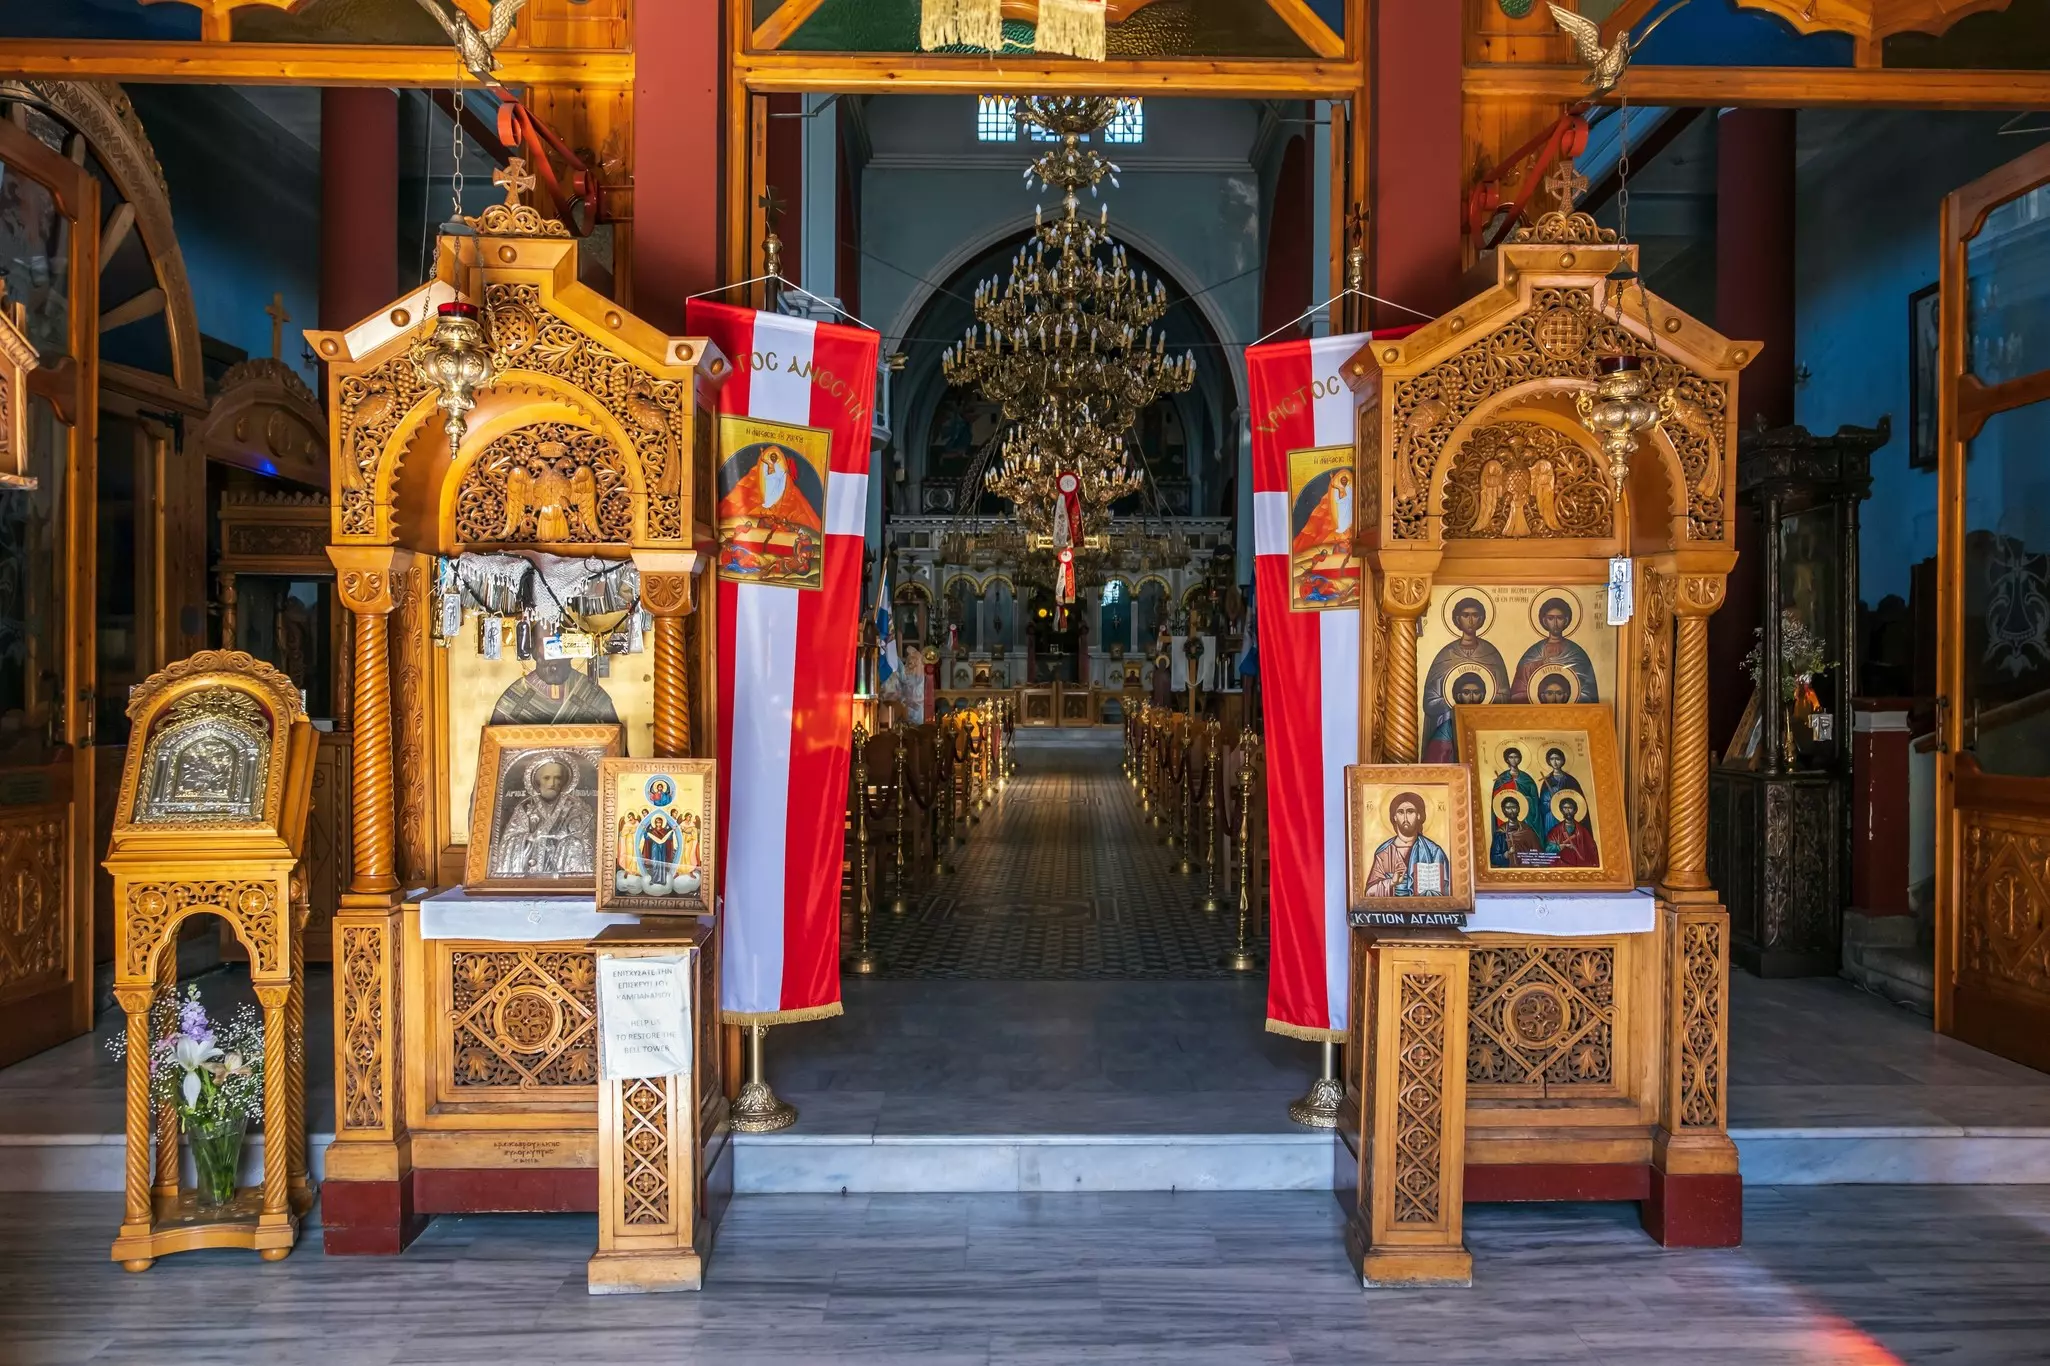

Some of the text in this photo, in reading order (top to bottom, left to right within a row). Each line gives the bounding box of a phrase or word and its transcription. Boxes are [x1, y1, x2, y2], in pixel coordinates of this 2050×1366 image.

[1354, 912, 1460, 925] ΚΥΤΙΟΝ ΑΓΑΠΗΣ
[630, 1019, 649, 1027] HELP
[628, 1032, 661, 1040] RESTORE
[642, 1045, 670, 1053] TOWER
